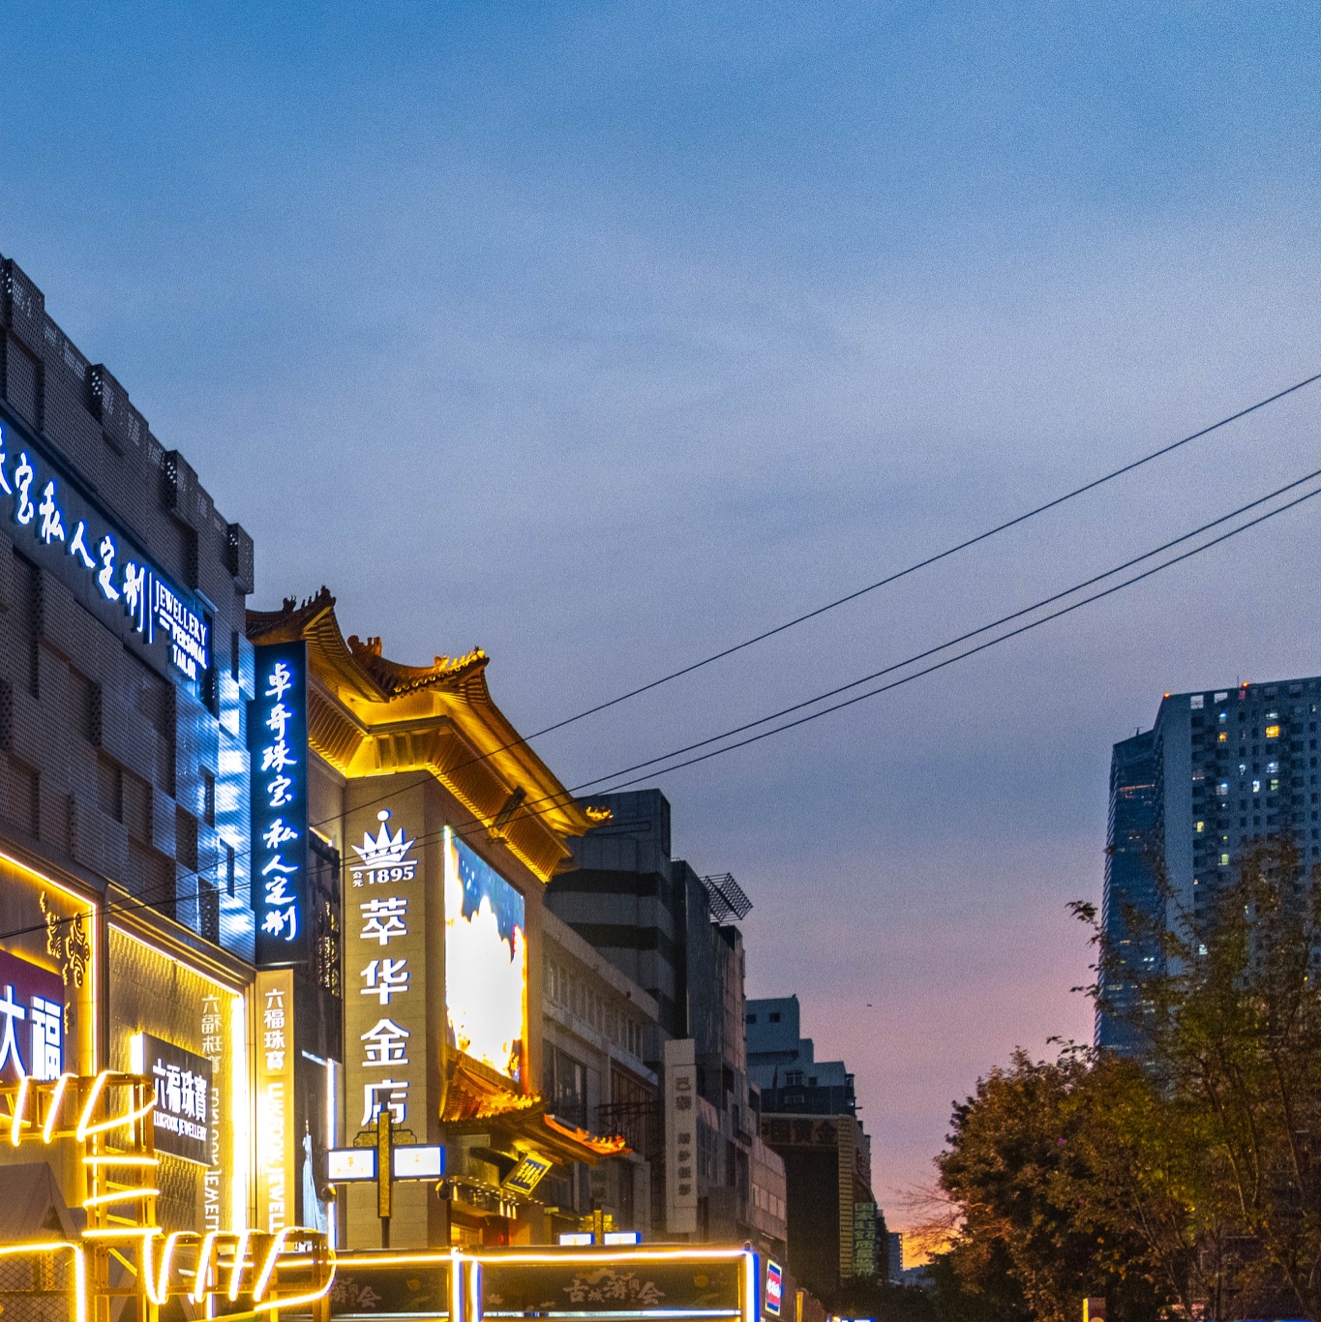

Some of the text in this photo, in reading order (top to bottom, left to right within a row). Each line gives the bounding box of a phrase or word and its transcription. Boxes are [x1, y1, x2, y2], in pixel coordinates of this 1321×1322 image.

[154, 580, 207, 646] JEWELLERY
[260, 662, 298, 942] 卓奇珠宝私人定制
[366, 865, 415, 885] 1895
[359, 897, 410, 1126] 萃华金店
